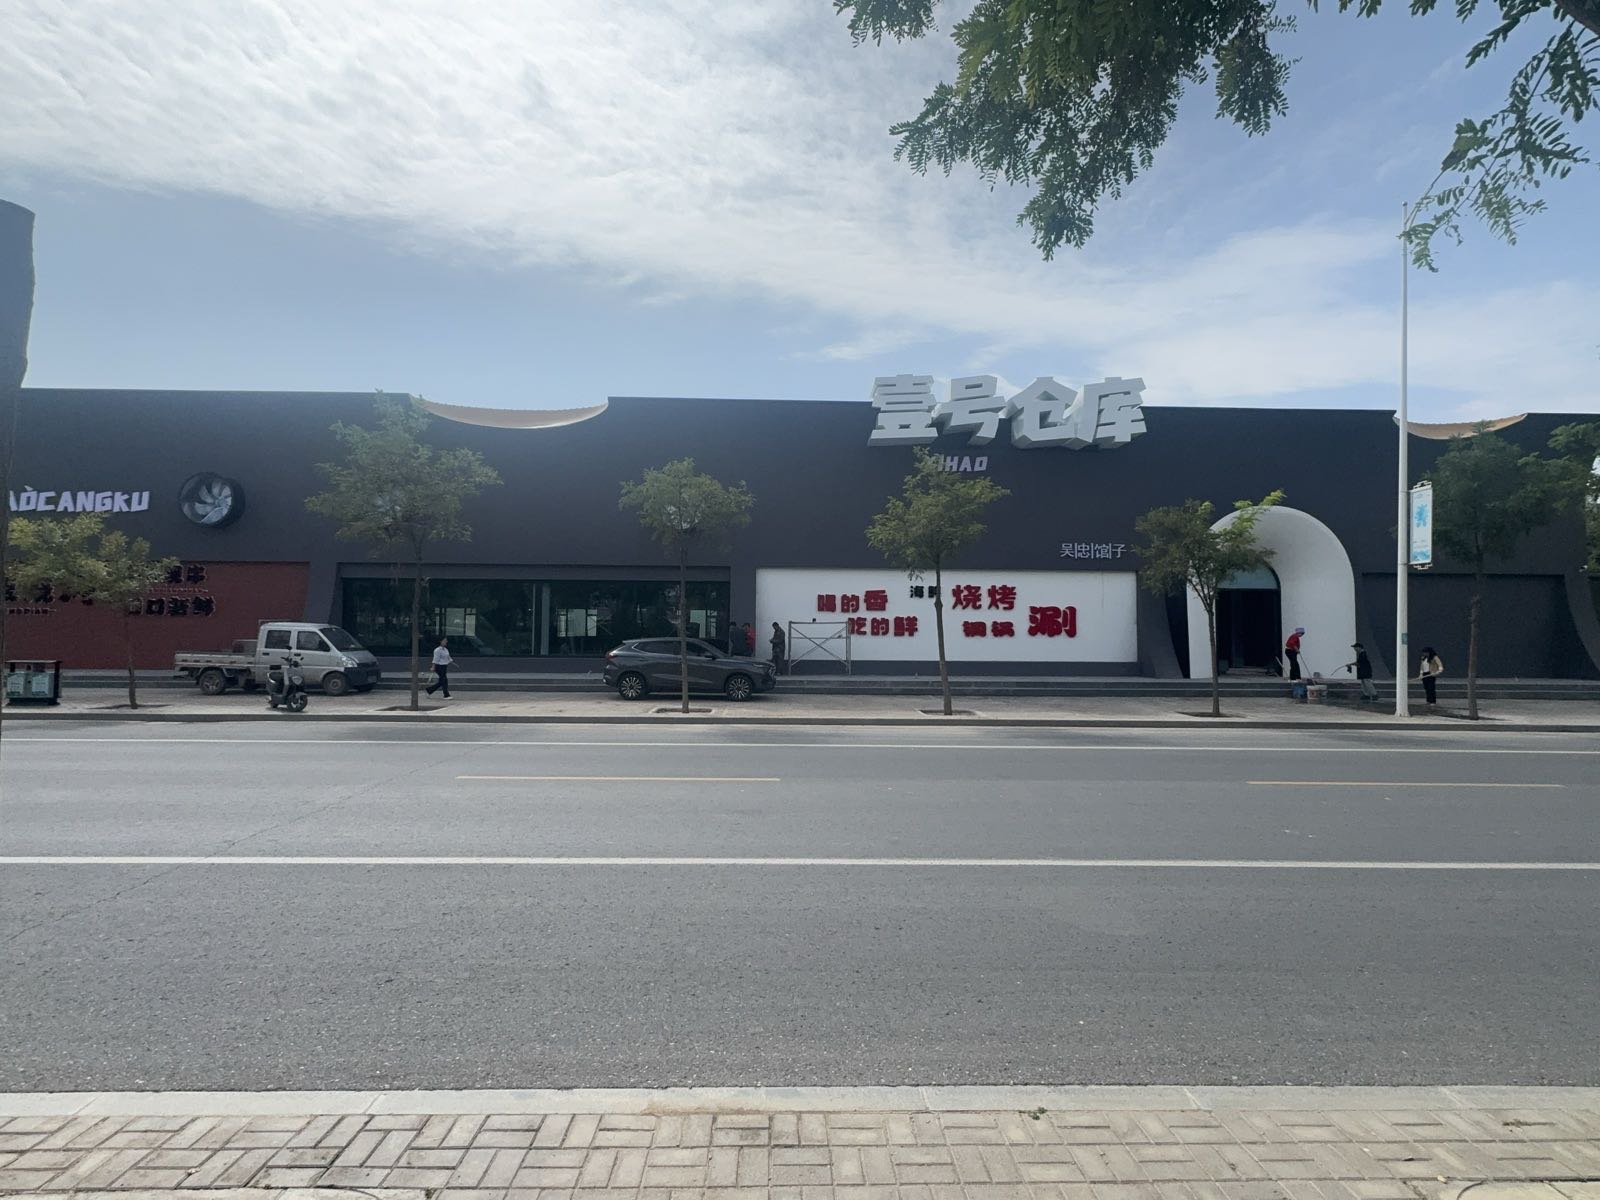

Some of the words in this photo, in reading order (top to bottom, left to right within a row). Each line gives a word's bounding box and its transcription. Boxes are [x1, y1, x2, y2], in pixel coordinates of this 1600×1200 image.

[868, 374, 1147, 448] 壹号仓库
[952, 584, 1017, 610] 烧烤
[848, 616, 918, 637] 吃的鲜
[1027, 606, 1077, 638] 涮
